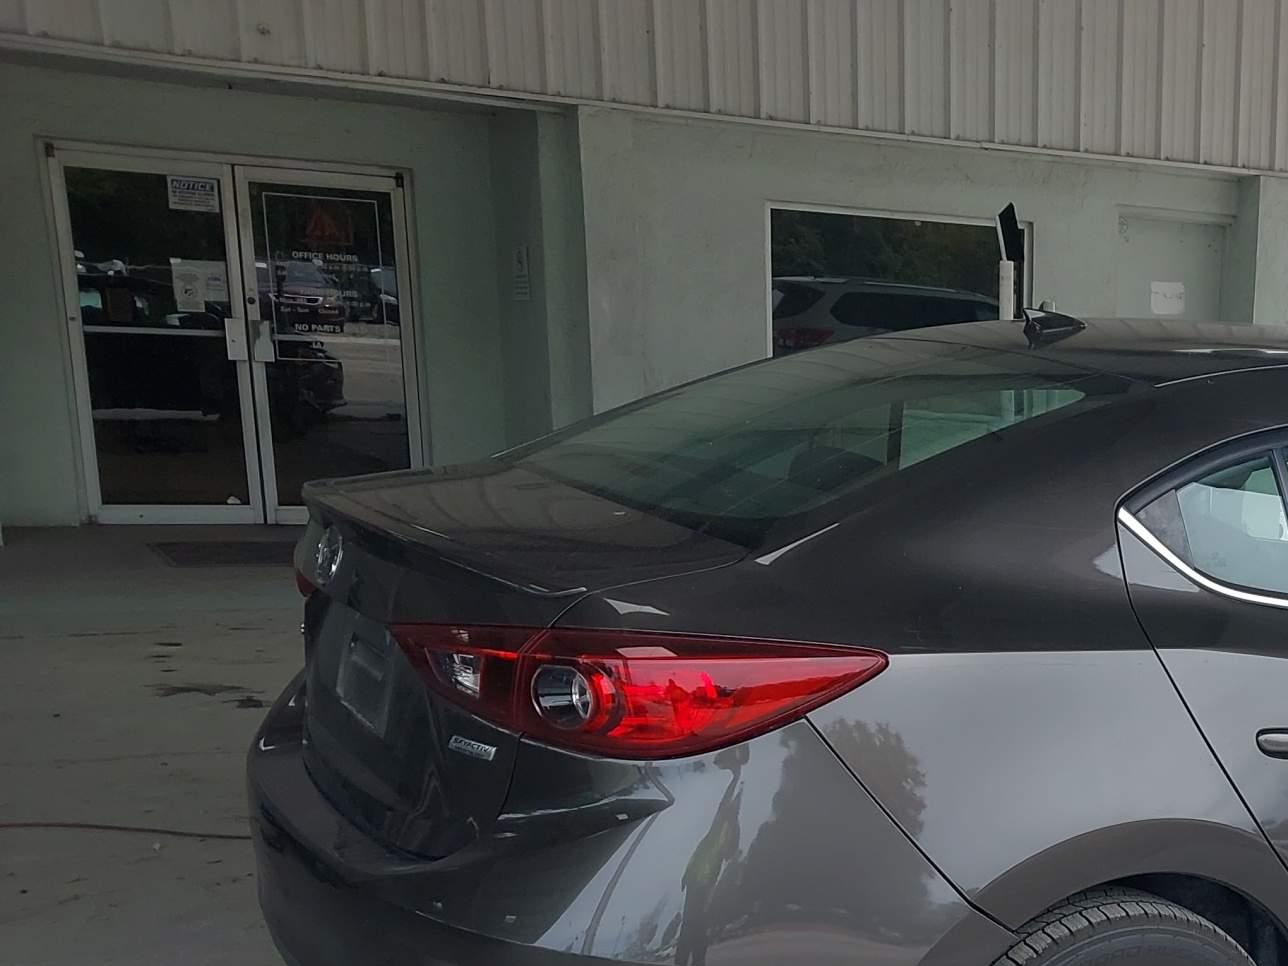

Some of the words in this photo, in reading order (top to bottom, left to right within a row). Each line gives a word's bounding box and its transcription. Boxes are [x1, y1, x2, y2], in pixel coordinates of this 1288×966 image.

[172, 180, 214, 191] NOTICE
[292, 251, 324, 260] OFFICE
[326, 253, 359, 262] HOURS
[295, 323, 309, 331] NO
[311, 324, 341, 333] PARTS
